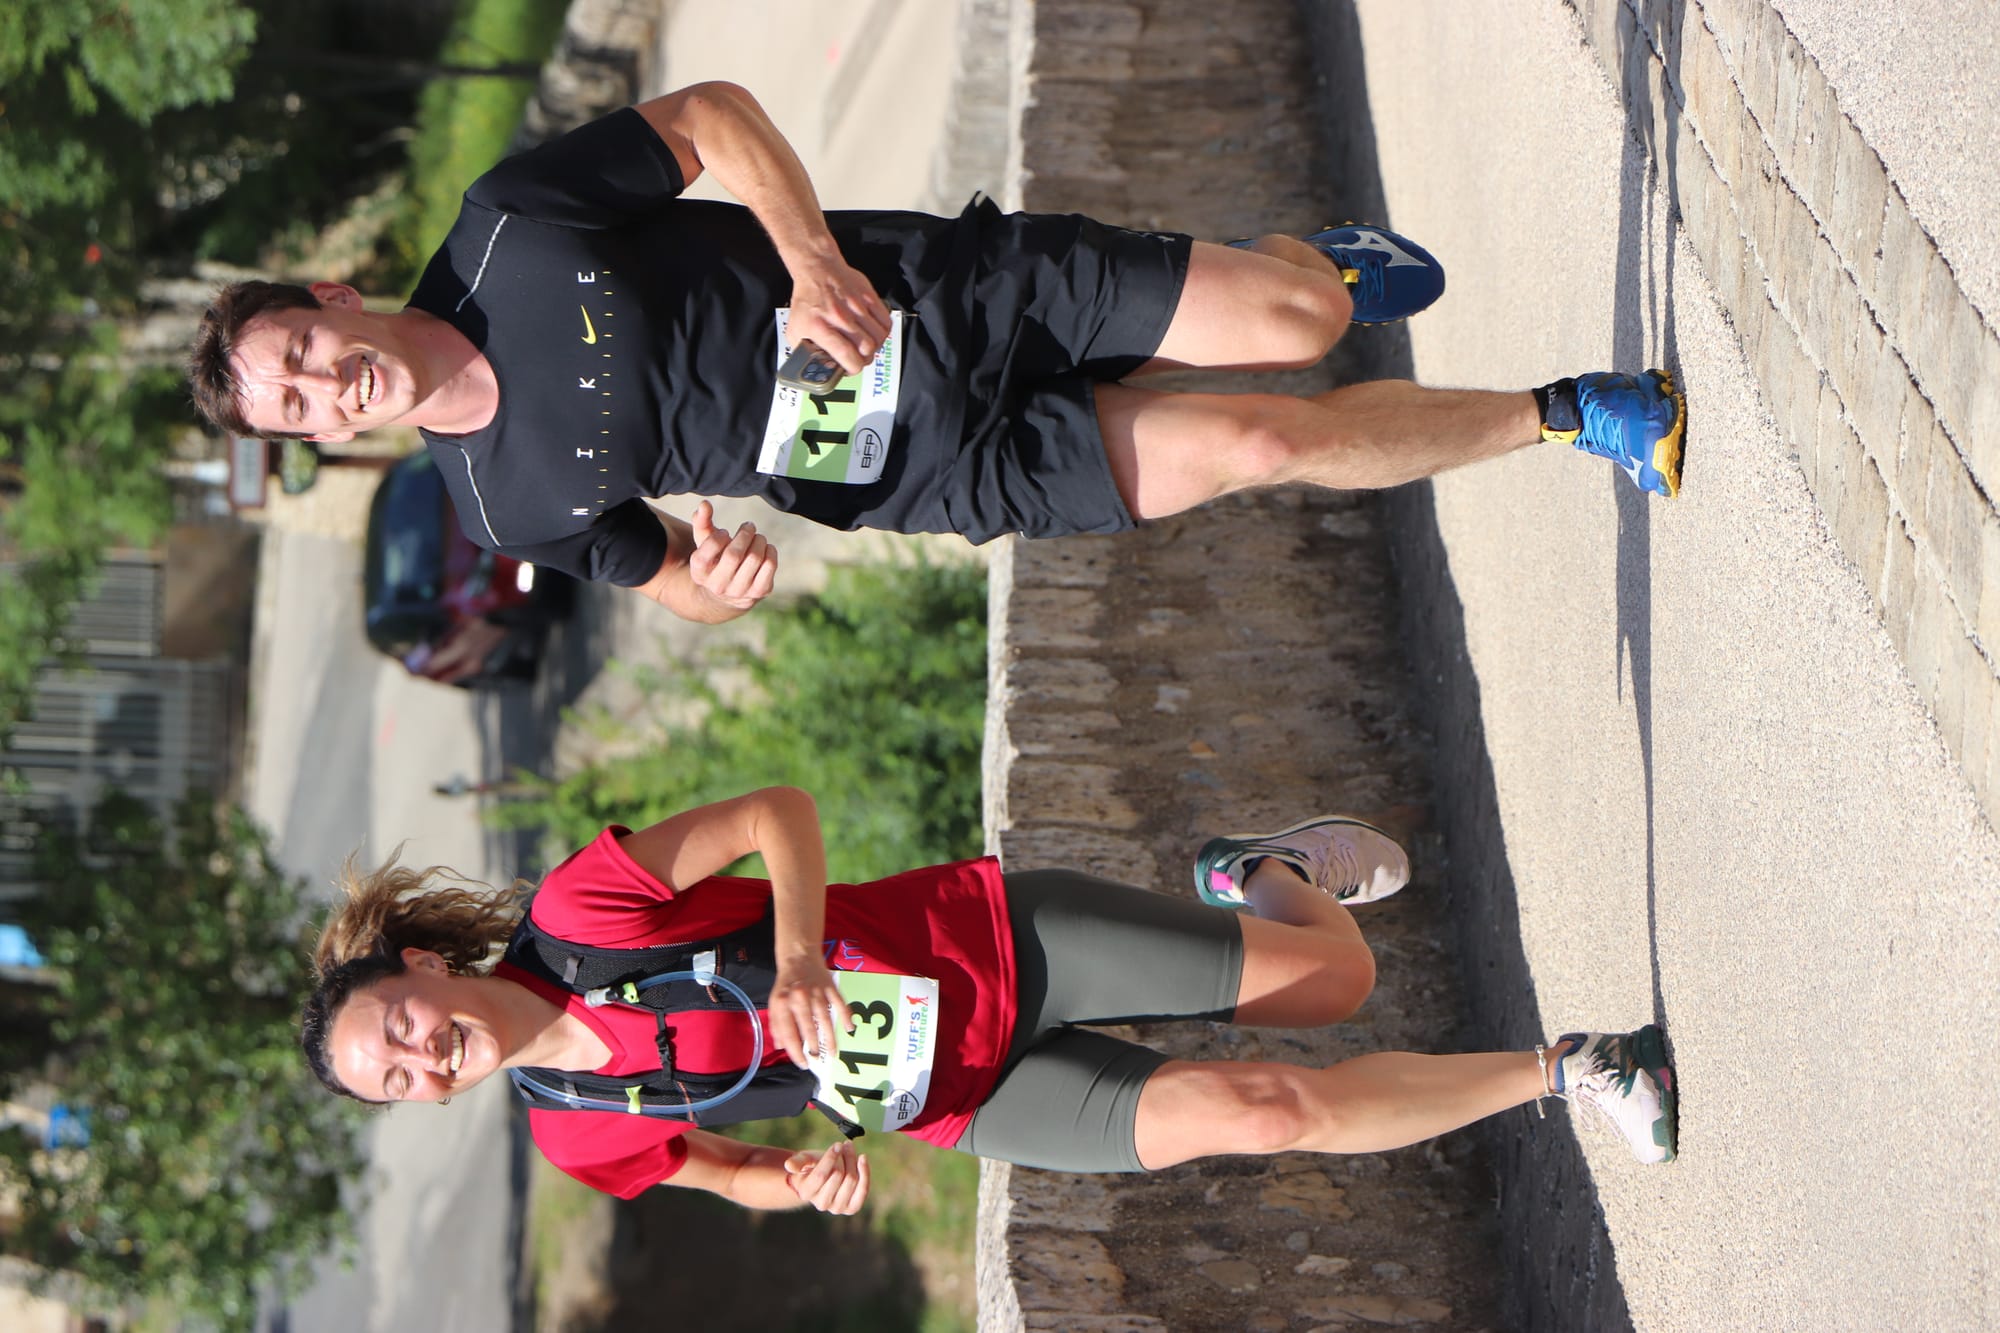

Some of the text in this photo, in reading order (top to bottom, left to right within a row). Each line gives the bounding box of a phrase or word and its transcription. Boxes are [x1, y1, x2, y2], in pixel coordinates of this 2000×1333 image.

[880, 340, 892, 393] Aventure
[860, 434, 875, 469] BFP
[834, 1000, 894, 1106] 113
[906, 1011, 920, 1063] TUFF'S
[915, 1006, 929, 1059] Aventure
[896, 1093, 910, 1121] BFP
